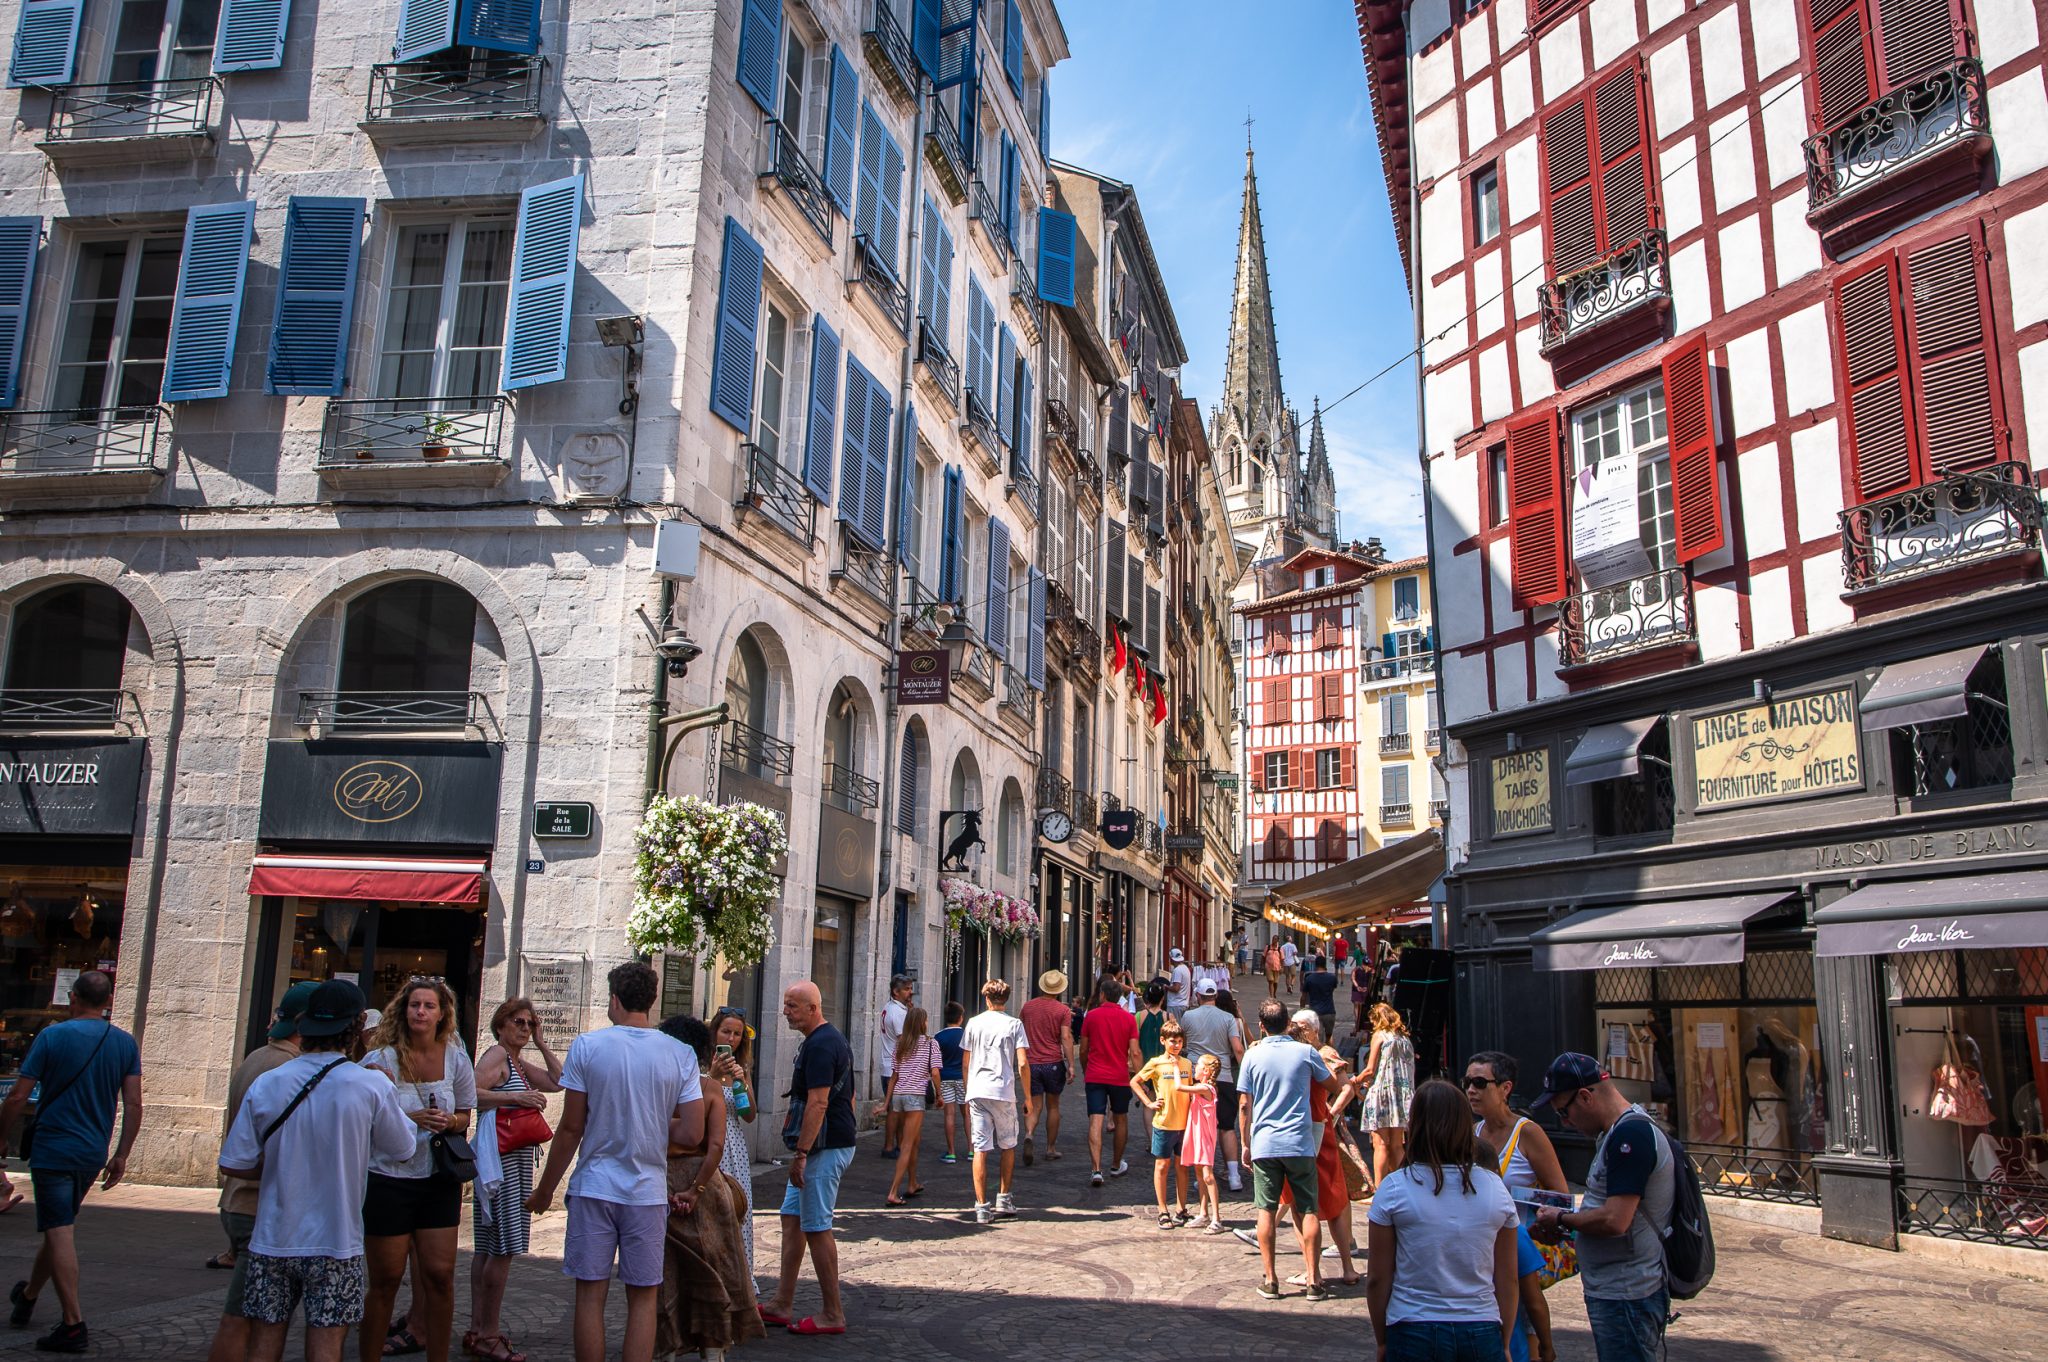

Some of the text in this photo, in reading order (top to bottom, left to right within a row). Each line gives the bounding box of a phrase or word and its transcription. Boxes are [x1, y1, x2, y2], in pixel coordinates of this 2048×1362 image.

[904, 681, 942, 689] MONTAUZER
[1694, 690, 1853, 751] LINGE de MAISON
[1499, 750, 1543, 781] DRAPS
[1698, 753, 1858, 804] FOURNITURE pour HÔTELS
[1218, 779, 1237, 787] ORTS
[1505, 779, 1539, 799] TAIES
[1495, 800, 1551, 833] MOUCHOIRS
[1815, 823, 2036, 869] MAISON DE BLANC
[529, 862, 540, 870] 23
[1898, 920, 1974, 950] Jean-Vier
[1603, 941, 1658, 965] Jean-Vier
[535, 1009, 564, 1018] RODUITS
